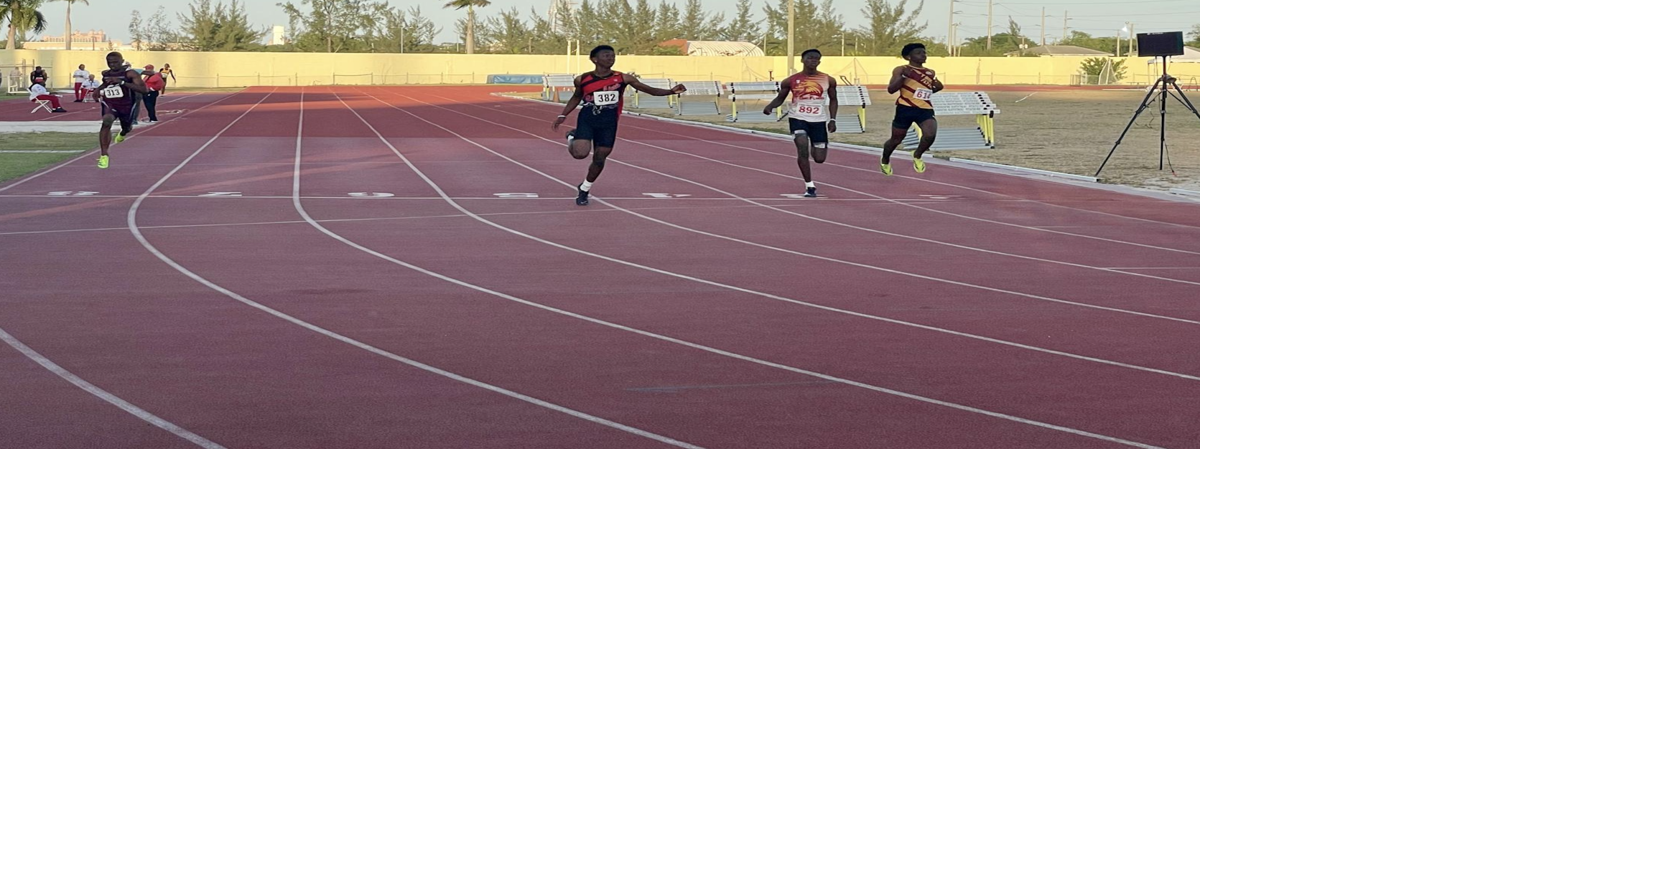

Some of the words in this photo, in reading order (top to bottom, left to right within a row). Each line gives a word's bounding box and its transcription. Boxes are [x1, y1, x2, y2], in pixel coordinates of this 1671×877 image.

[106, 89, 121, 97] 313
[597, 93, 616, 103] 382
[798, 106, 820, 114] 892
